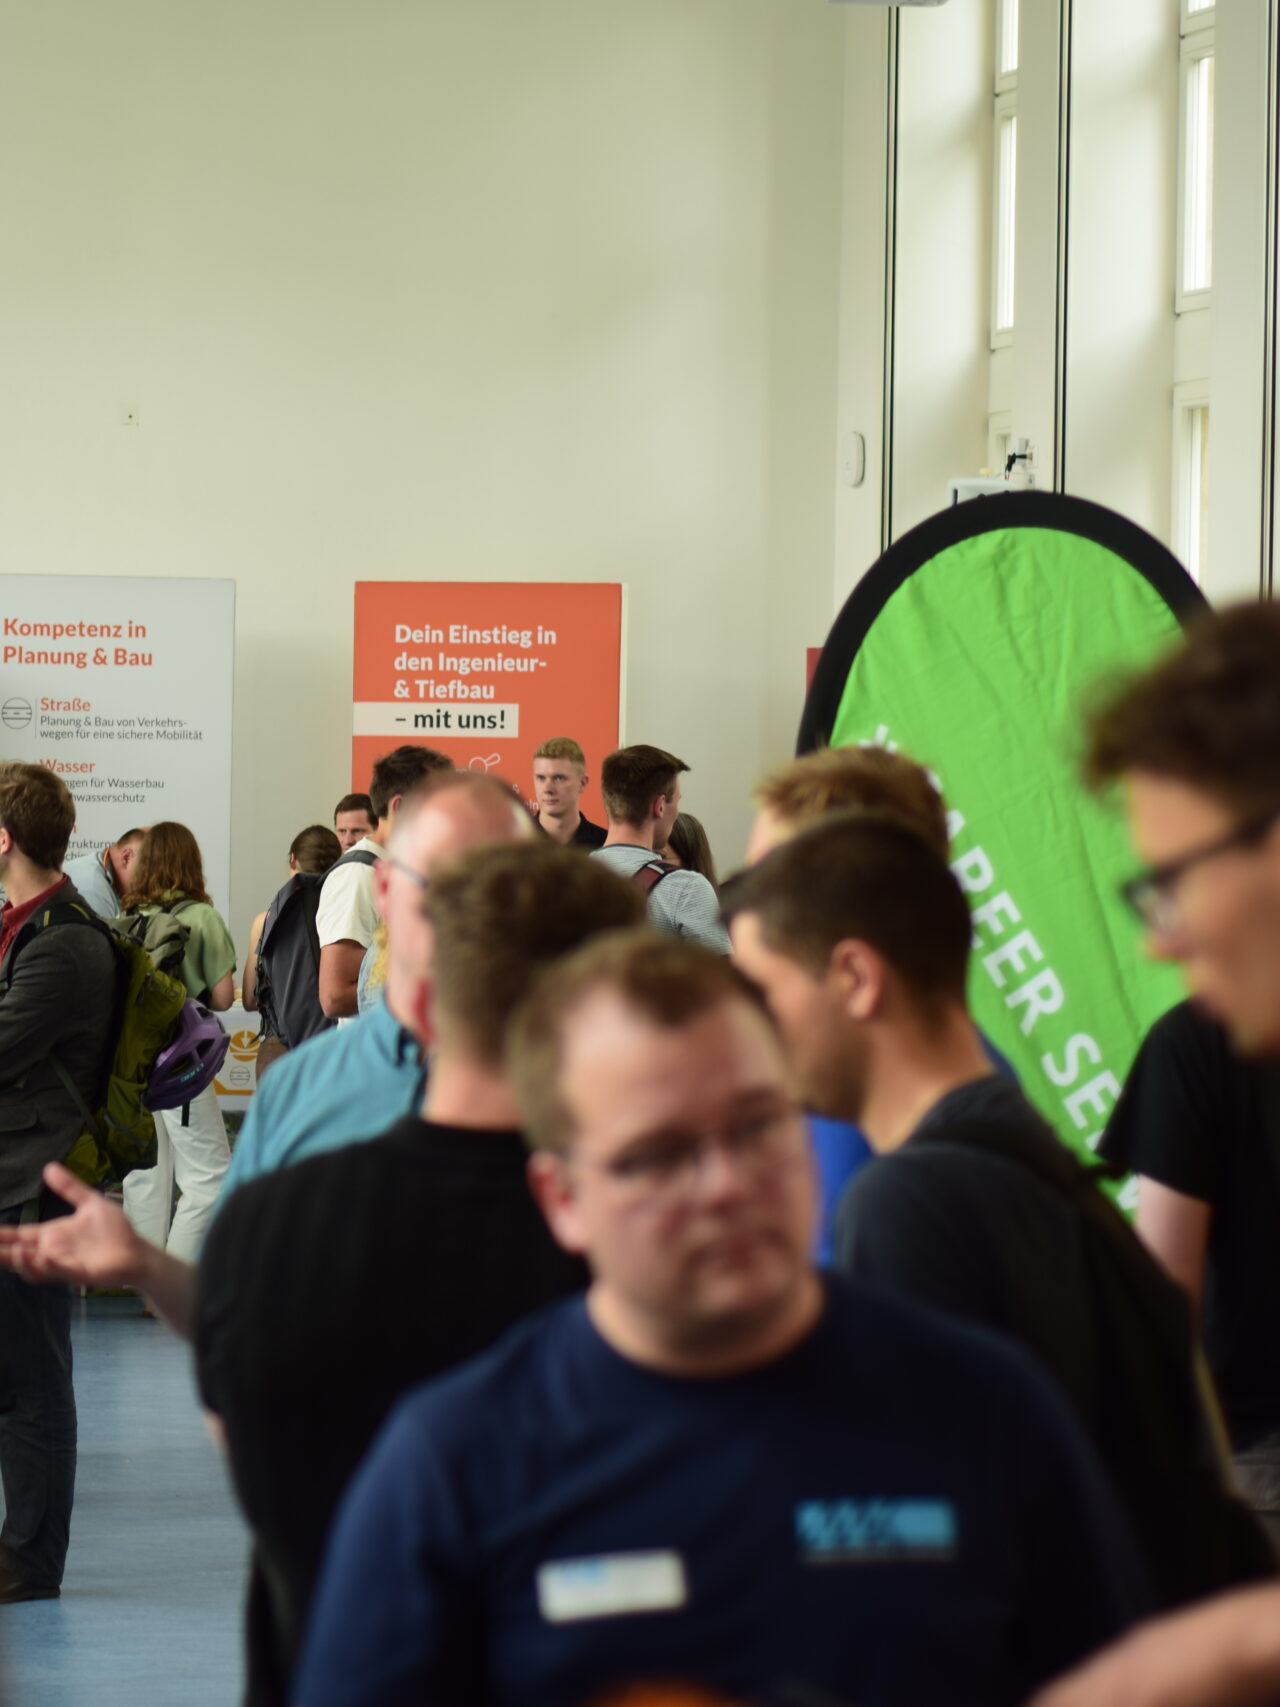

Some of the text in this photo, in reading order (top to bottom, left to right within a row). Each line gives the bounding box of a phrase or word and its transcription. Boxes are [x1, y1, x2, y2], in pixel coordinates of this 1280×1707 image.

[3, 617, 147, 640] Kompetenz in
[395, 624, 557, 648] Dein Einstieg in
[3, 646, 153, 669] Planung & Bau
[393, 652, 547, 675] den Ingenieur-
[393, 679, 495, 699] & Tiefbau
[40, 697, 91, 712] Straße
[40, 715, 188, 728] Planung & Bau von Verkehrs-
[414, 709, 451, 729] mit
[457, 709, 506, 729] uns!
[40, 729, 203, 741] wegen für eine sichere Mobilität
[91, 778, 106, 788] für
[108, 778, 164, 789] Wasserbau
